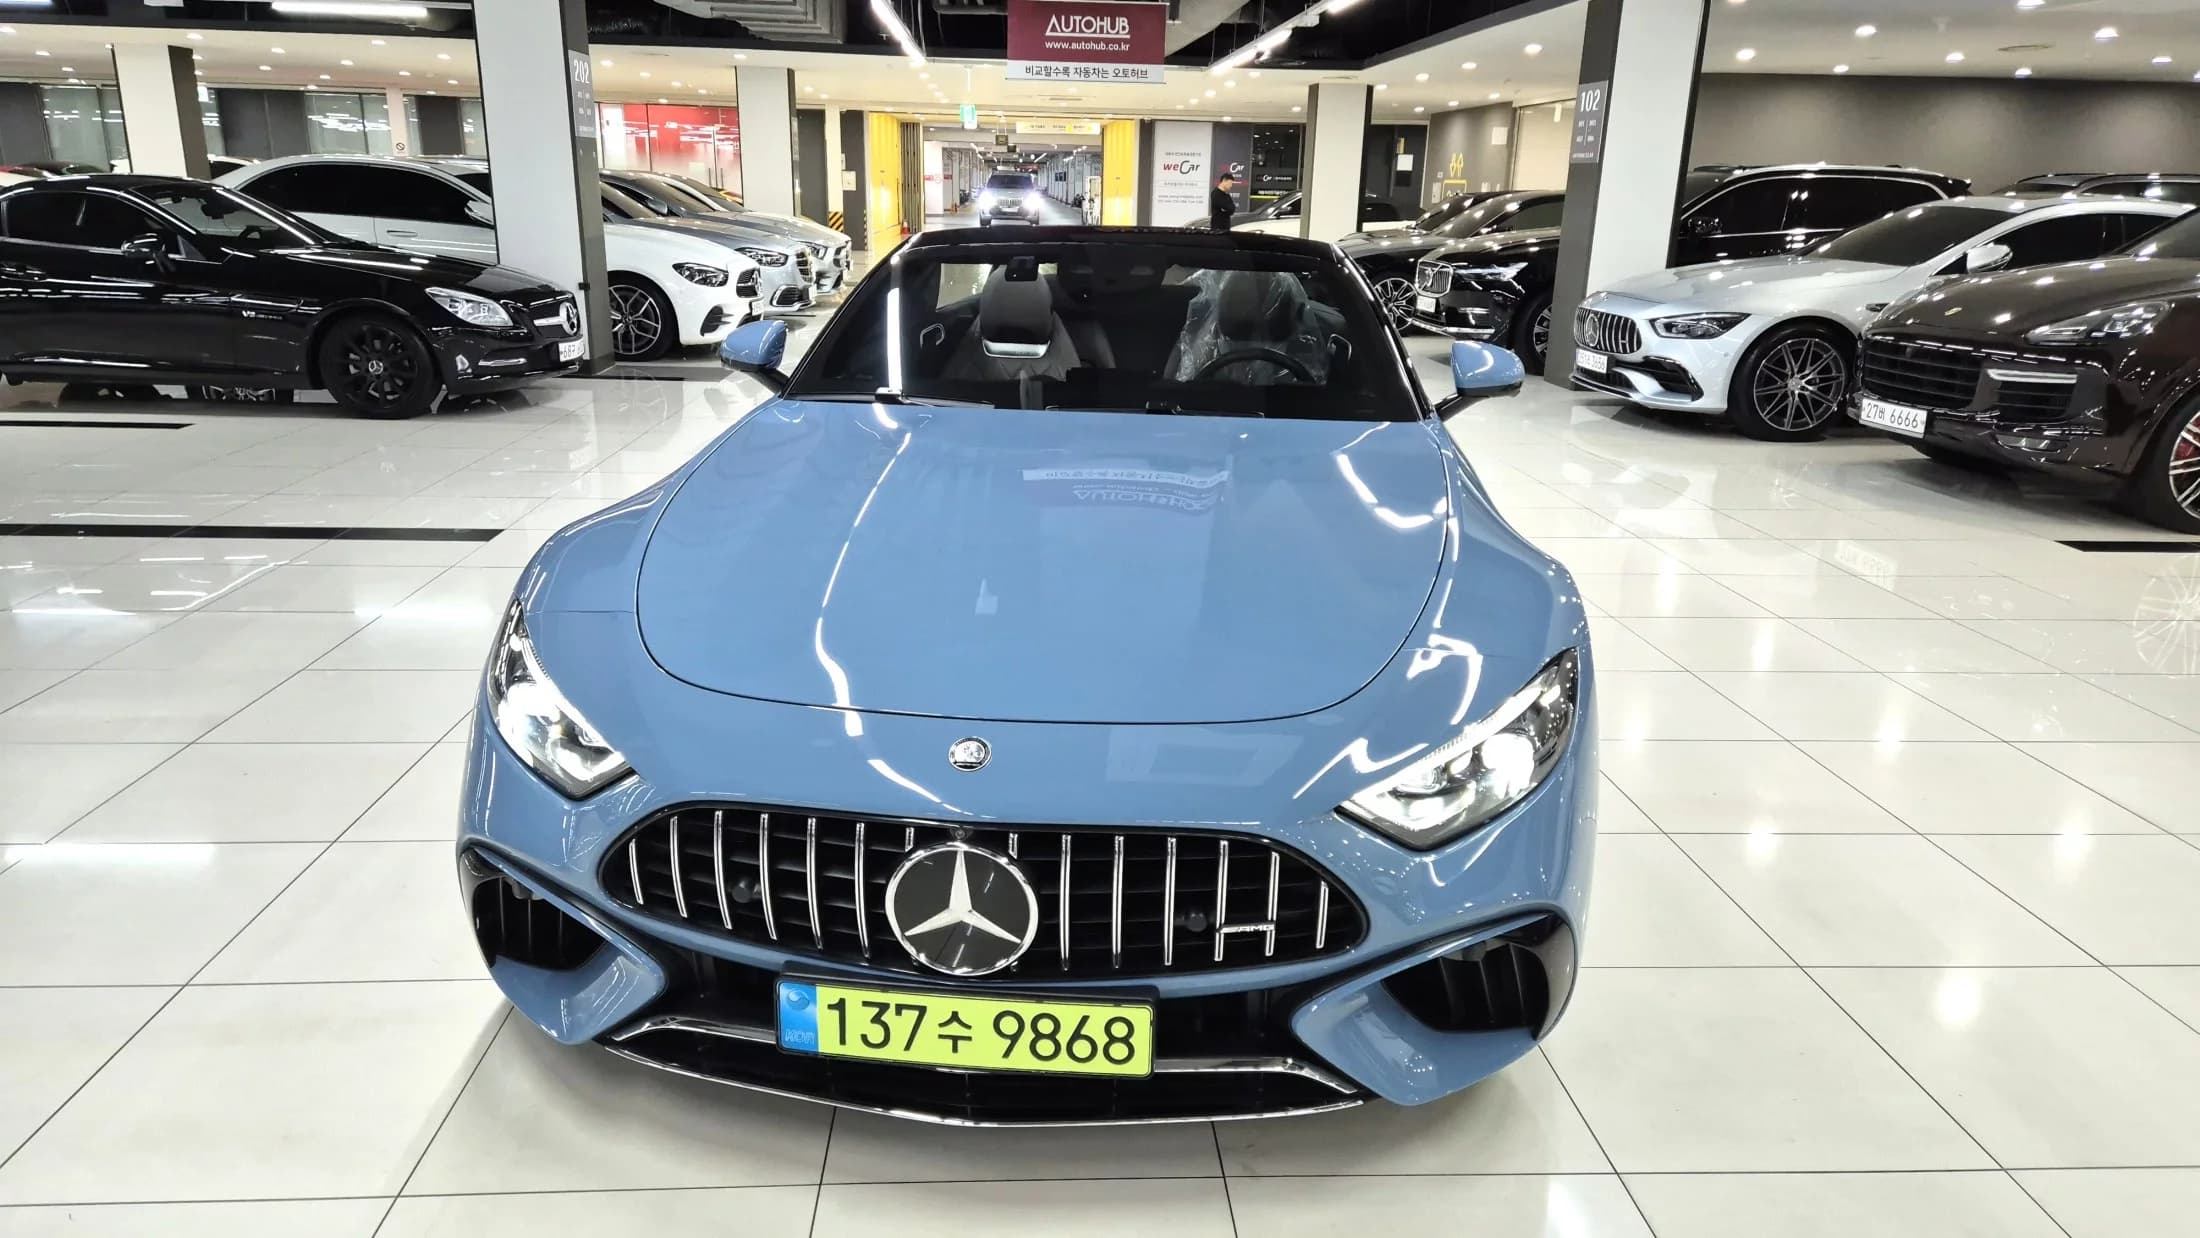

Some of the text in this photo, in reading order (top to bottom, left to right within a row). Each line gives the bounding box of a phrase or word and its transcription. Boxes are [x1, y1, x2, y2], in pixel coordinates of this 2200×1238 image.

[1045, 14, 1130, 38] AUTOHUB
[1045, 41, 1130, 51] www.autohub.co.kr
[574, 59, 591, 83] 202
[1025, 65, 1148, 79] 비교할수록 자동차는 오토허브
[1580, 89, 1600, 112] 102
[1163, 160, 1200, 174] weCar
[1890, 409, 1918, 428] 6666
[827, 997, 1135, 1065] 137수 9868
